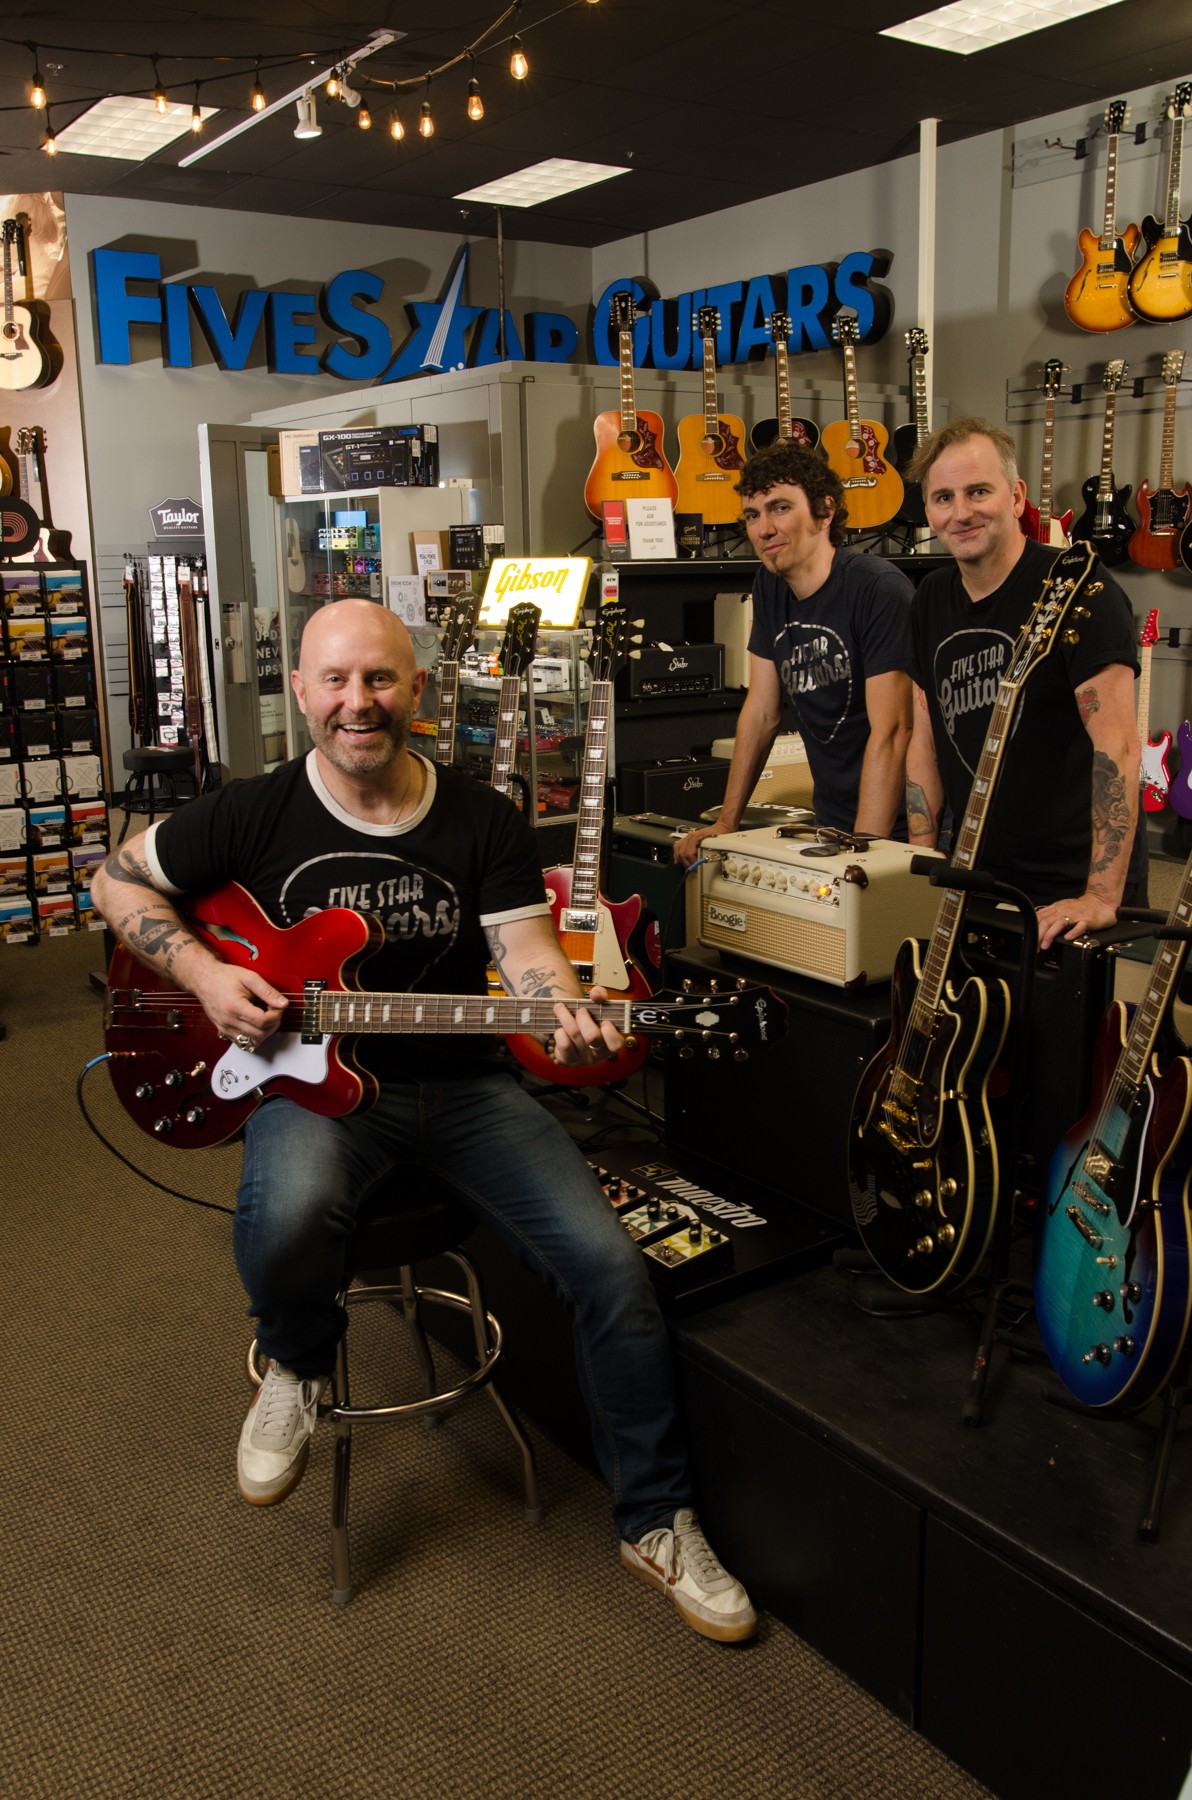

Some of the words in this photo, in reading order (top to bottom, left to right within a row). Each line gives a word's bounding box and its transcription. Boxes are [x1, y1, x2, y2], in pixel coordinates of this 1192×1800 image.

[593, 251, 875, 370] GUITARS
[322, 432, 351, 442] GX-100
[157, 508, 200, 526] Taylor
[494, 562, 570, 603] Gibson
[601, 606, 627, 617] Epiphone
[949, 653, 975, 683] FIVE
[977, 643, 1005, 674] STAR
[940, 669, 1003, 736] Guita
[325, 884, 371, 911] FIVE
[376, 873, 424, 908] STAR
[709, 906, 745, 927] Boogie
[755, 997, 768, 1041] Epiphone
[654, 1175, 768, 1229] maestro
